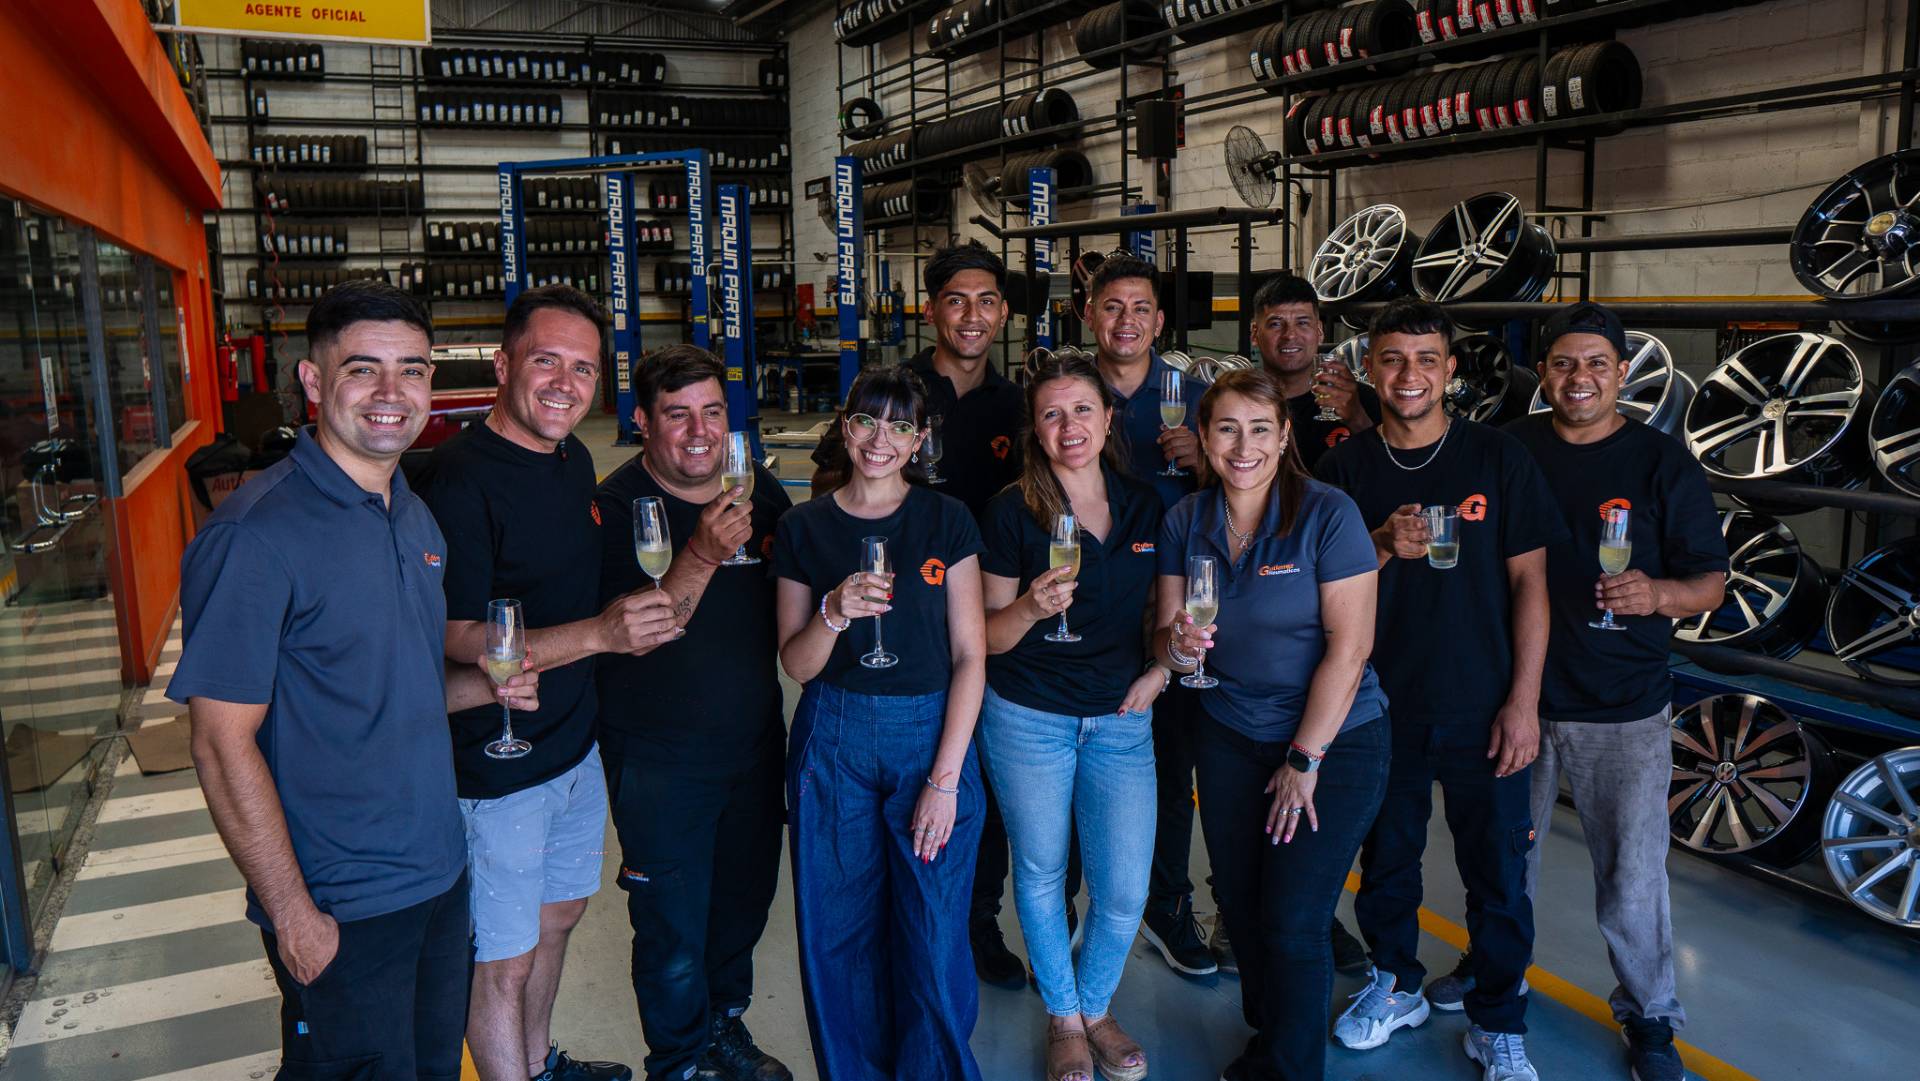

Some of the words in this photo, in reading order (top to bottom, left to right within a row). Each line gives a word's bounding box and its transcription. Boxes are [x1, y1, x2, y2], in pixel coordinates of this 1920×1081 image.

[245, 3, 302, 18] AGENTE
[311, 8, 367, 23] OFICIAL
[503, 232, 517, 283] PARTS
[691, 223, 705, 277] PARTS
[839, 242, 856, 306] PARTS
[611, 250, 628, 311] PARTS
[724, 274, 741, 339] PARTS
[1458, 493, 1487, 522] G
[919, 558, 946, 586] G
